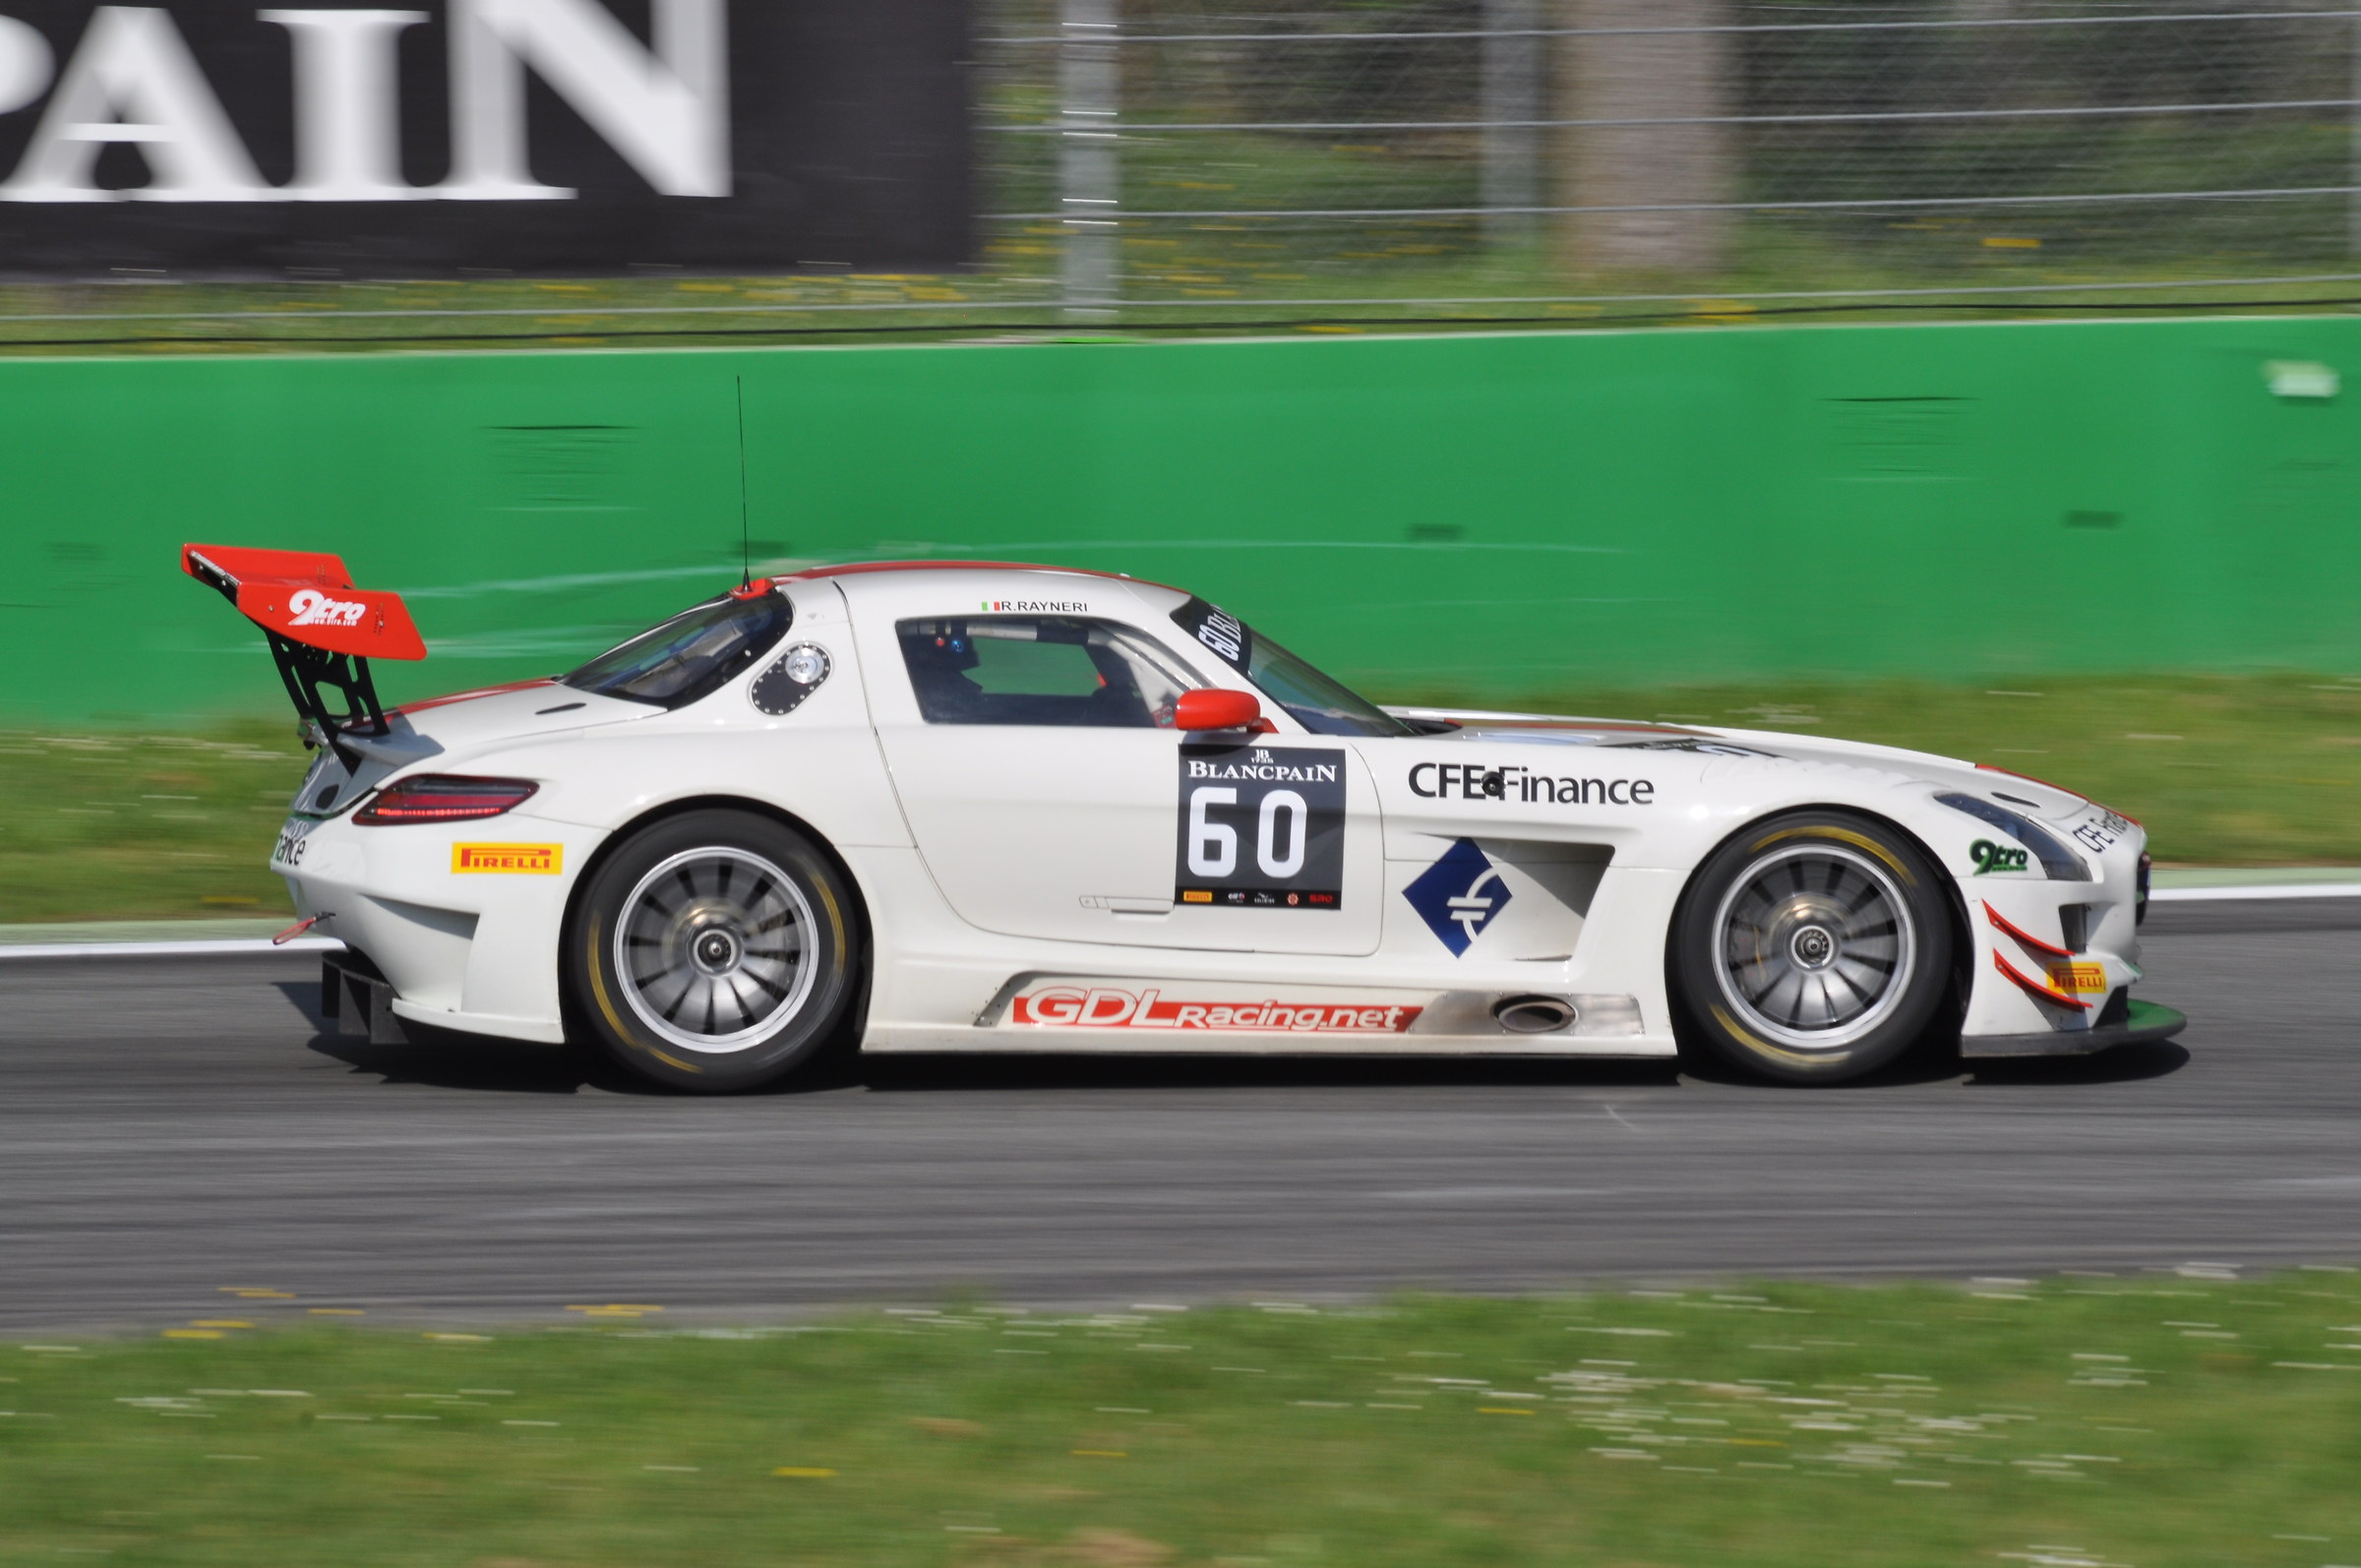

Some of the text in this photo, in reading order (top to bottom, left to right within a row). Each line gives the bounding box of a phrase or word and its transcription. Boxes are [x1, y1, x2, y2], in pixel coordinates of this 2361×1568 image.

[1187, 760, 1337, 782] BLANCPAIN
[1408, 762, 1655, 805] CFE Finance
[1187, 786, 1307, 878] 60
[460, 848, 552, 869] PIRELLI
